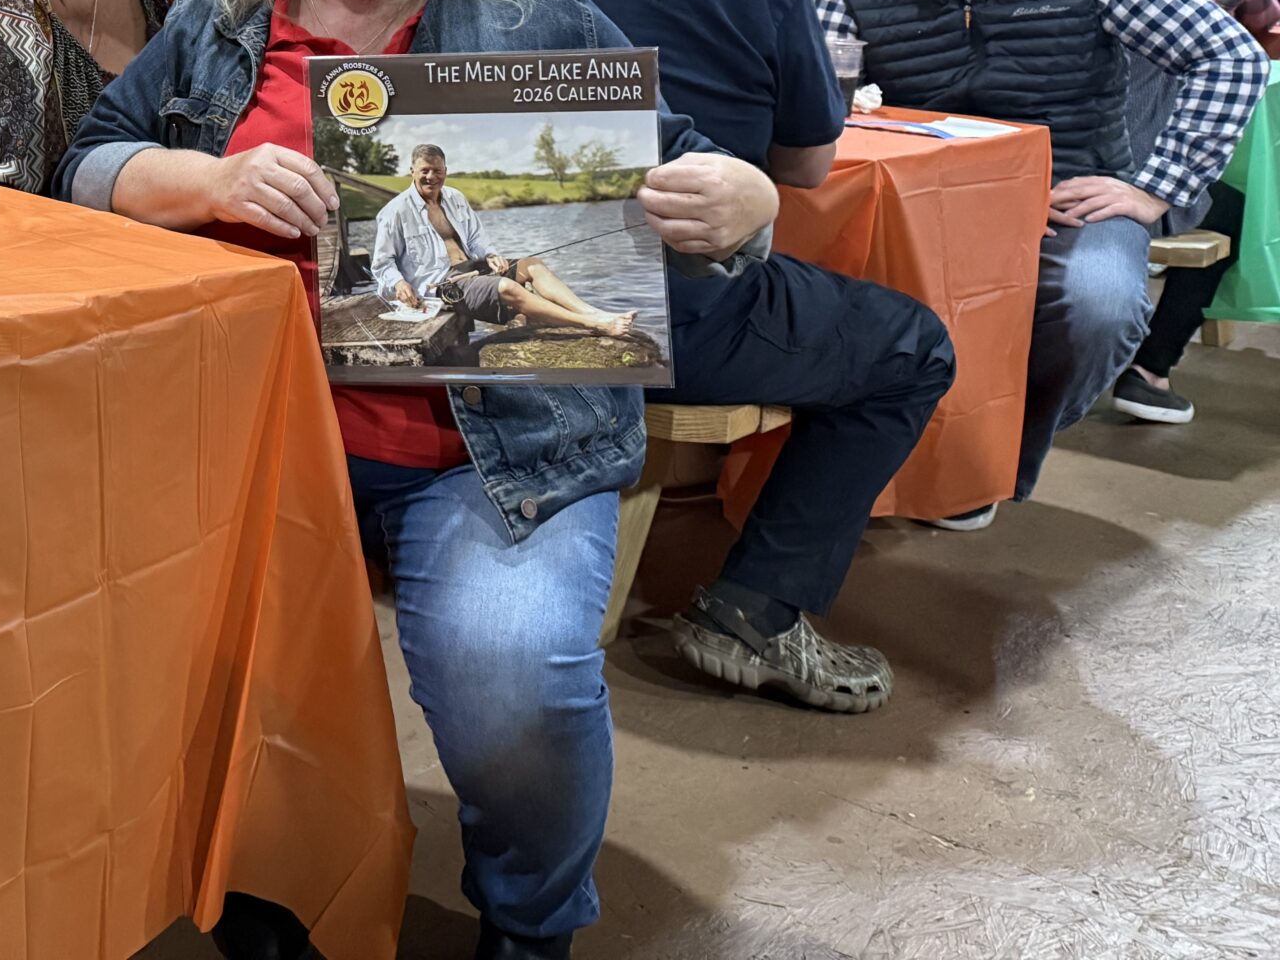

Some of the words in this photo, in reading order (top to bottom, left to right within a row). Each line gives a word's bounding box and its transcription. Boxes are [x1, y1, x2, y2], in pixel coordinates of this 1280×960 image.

[317, 80, 329, 98] LAKE
[325, 66, 344, 82] ANNA
[342, 62, 379, 74] ROOSTERS
[377, 70, 384, 78] &
[382, 75, 396, 96] FOXES
[424, 62, 460, 83] THE
[465, 61, 506, 83] MEN
[511, 63, 534, 82] OF
[538, 59, 583, 81] LAKE
[586, 58, 643, 80] ANNA
[513, 88, 553, 103] 2026
[556, 83, 643, 102] CALENDAR
[339, 124, 360, 136] SOCIAL
[361, 126, 377, 136] CLUB
